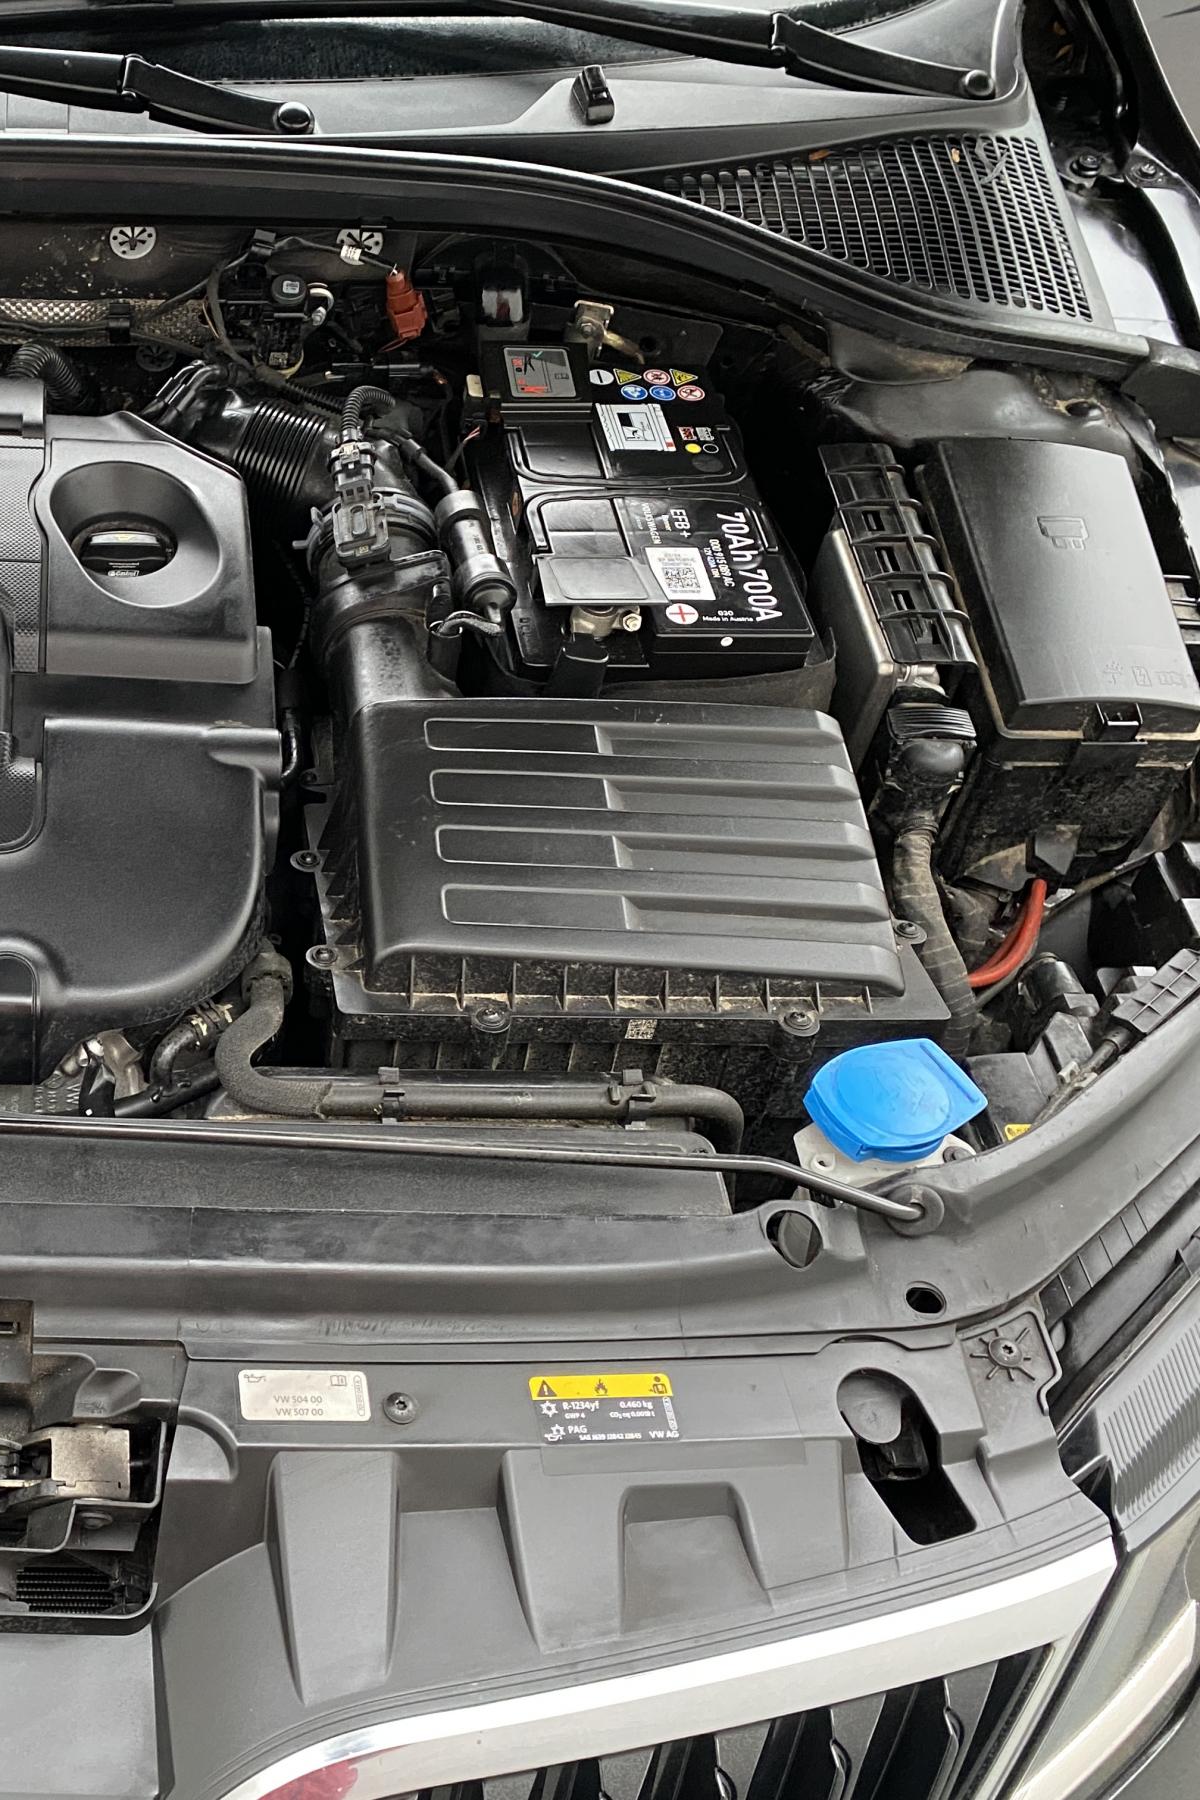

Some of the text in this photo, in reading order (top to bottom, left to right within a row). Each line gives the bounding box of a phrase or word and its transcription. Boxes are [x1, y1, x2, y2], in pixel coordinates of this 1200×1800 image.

[641, 502, 662, 545] VOLKSWAGEN
[716, 512, 783, 622] 70Ah 700A
[273, 1395, 323, 1404] VW 504 00
[562, 1401, 600, 1412] R-1234yf
[642, 1401, 654, 1410] kg
[275, 1408, 324, 1417] VW 507 00
[567, 1425, 588, 1435] PAG
[649, 1431, 665, 1440] VW
[666, 1430, 680, 1439] AG
